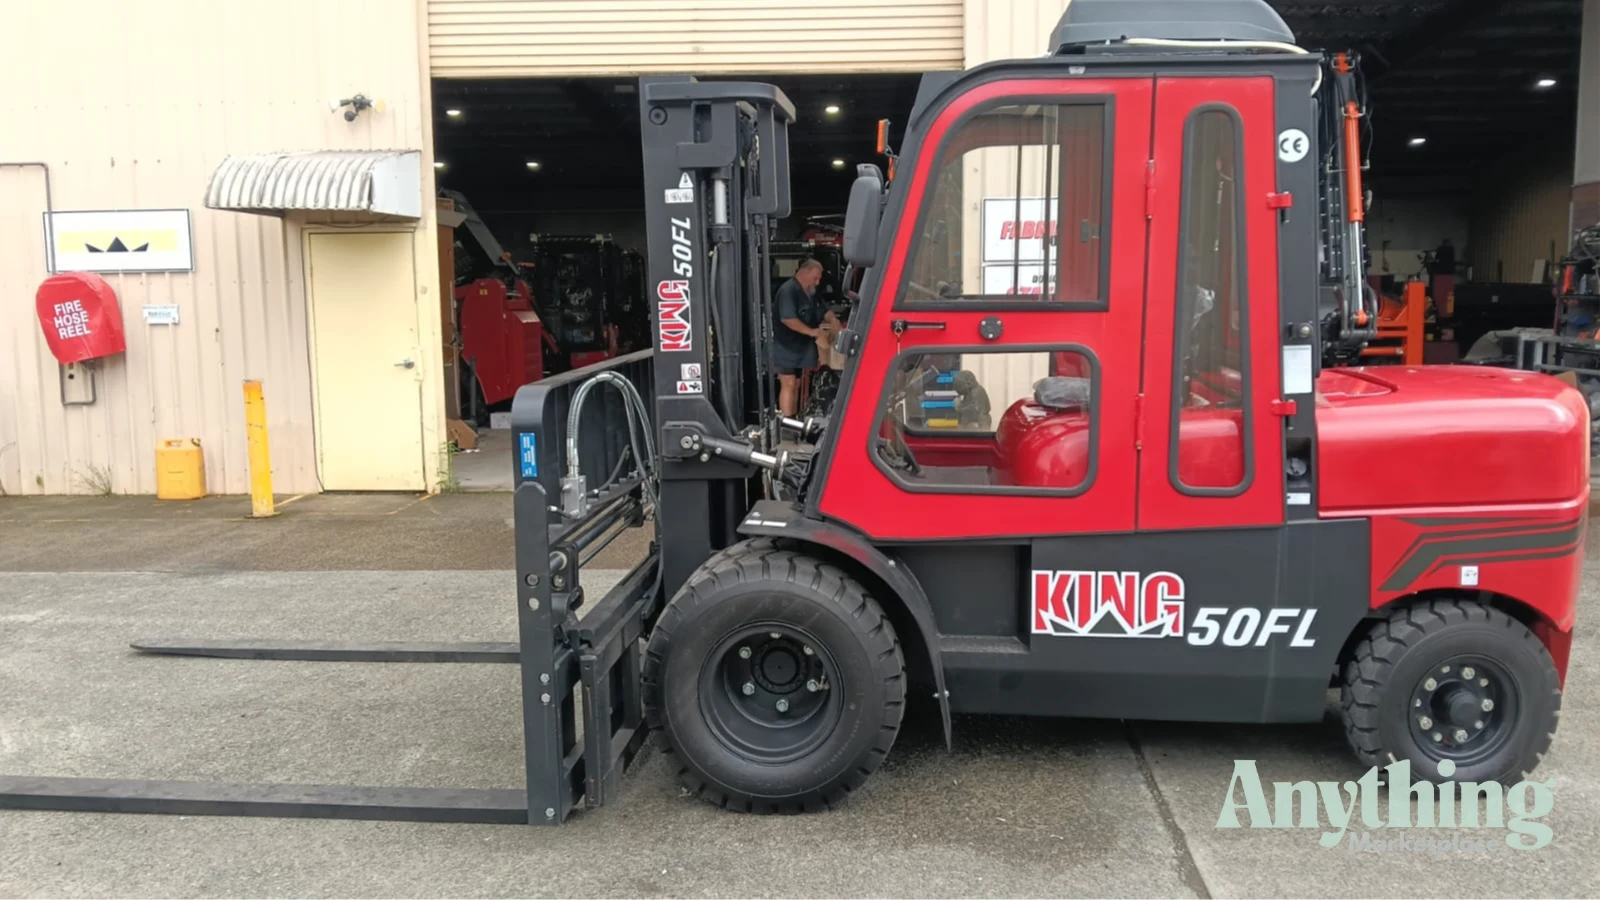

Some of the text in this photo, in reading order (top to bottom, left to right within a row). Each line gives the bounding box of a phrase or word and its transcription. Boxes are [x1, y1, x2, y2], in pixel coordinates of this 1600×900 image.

[1280, 137, 1302, 154] CE
[671, 217, 693, 278] 50FL
[53, 299, 84, 316] FIRE
[657, 280, 692, 352] KING
[53, 310, 90, 329] HOSE
[58, 323, 92, 340] REEL
[1031, 570, 1318, 648] KING 50FL
